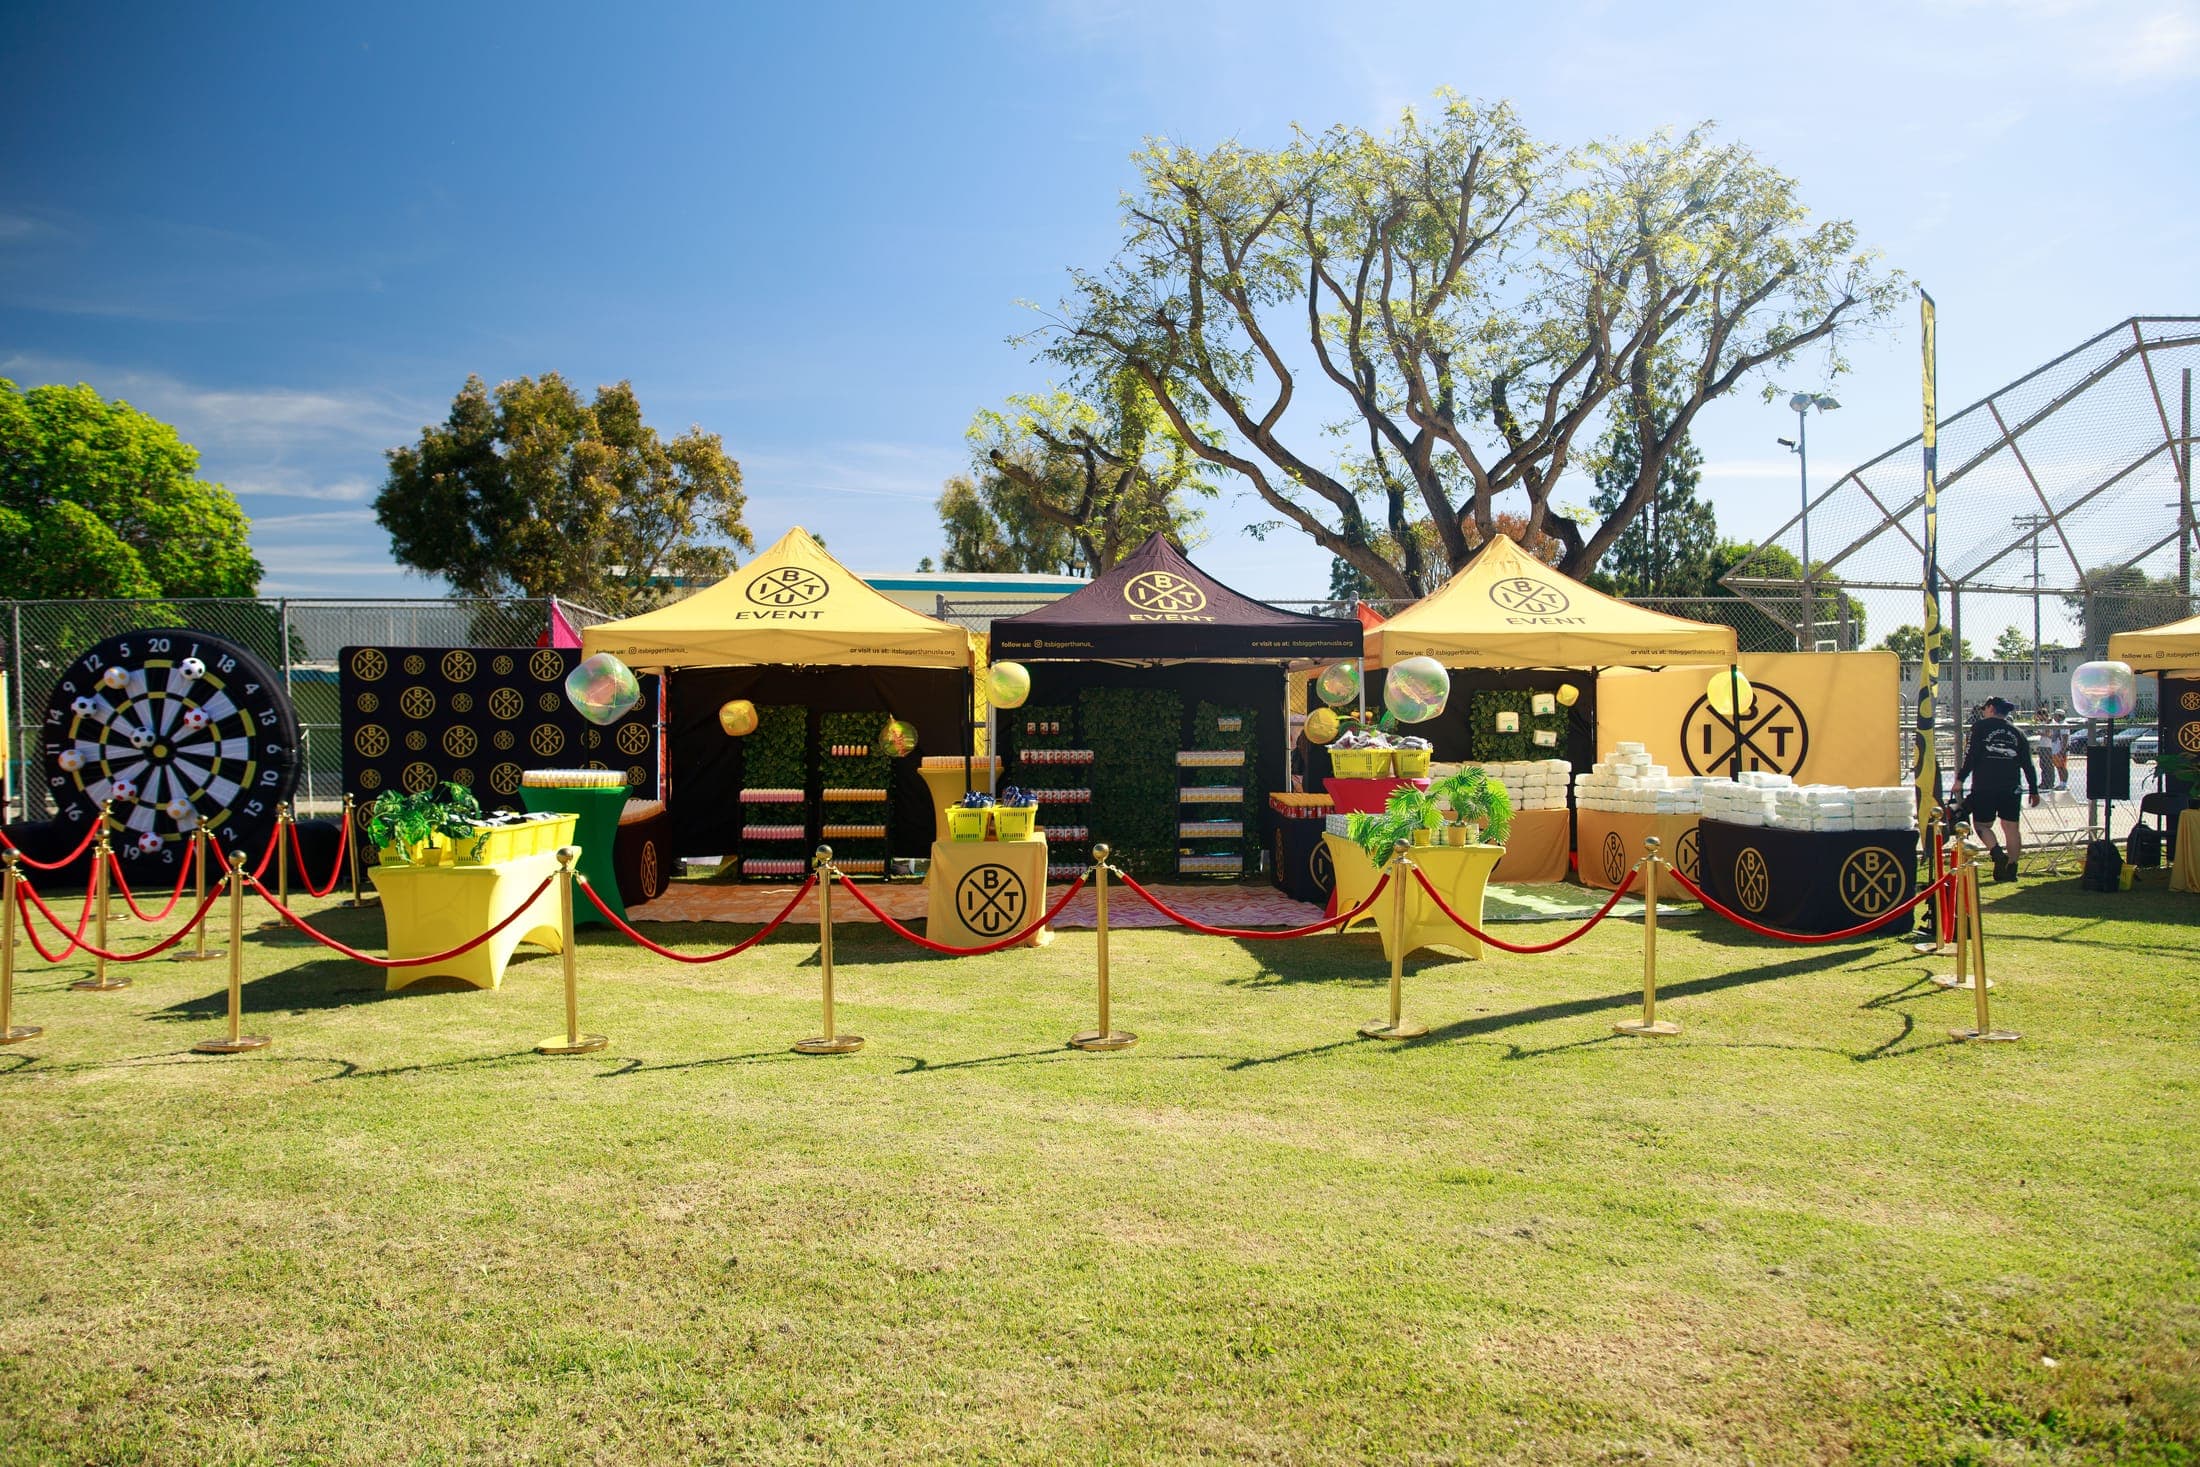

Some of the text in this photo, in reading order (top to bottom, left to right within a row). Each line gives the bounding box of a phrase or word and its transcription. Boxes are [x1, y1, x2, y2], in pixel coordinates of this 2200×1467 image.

[735, 610, 825, 620] EVENT
[1129, 614, 1216, 622] EVENT
[1505, 617, 1586, 625] EVENT
[119, 643, 130, 657] 5
[148, 638, 170, 653] 20
[190, 643, 199, 657] 1
[83, 654, 103, 673] 12
[216, 654, 236, 673] 18
[62, 681, 76, 693] 9
[245, 683, 260, 695] 4
[46, 708, 64, 725] 14
[258, 708, 277, 726] 13
[46, 743, 60, 755] 11
[50, 776, 66, 787] 8
[260, 770, 279, 787] 10
[64, 802, 83, 821] 16
[243, 799, 264, 817] 15
[223, 827, 238, 841] 2
[123, 844, 140, 860] 19
[162, 849, 173, 864] 3
